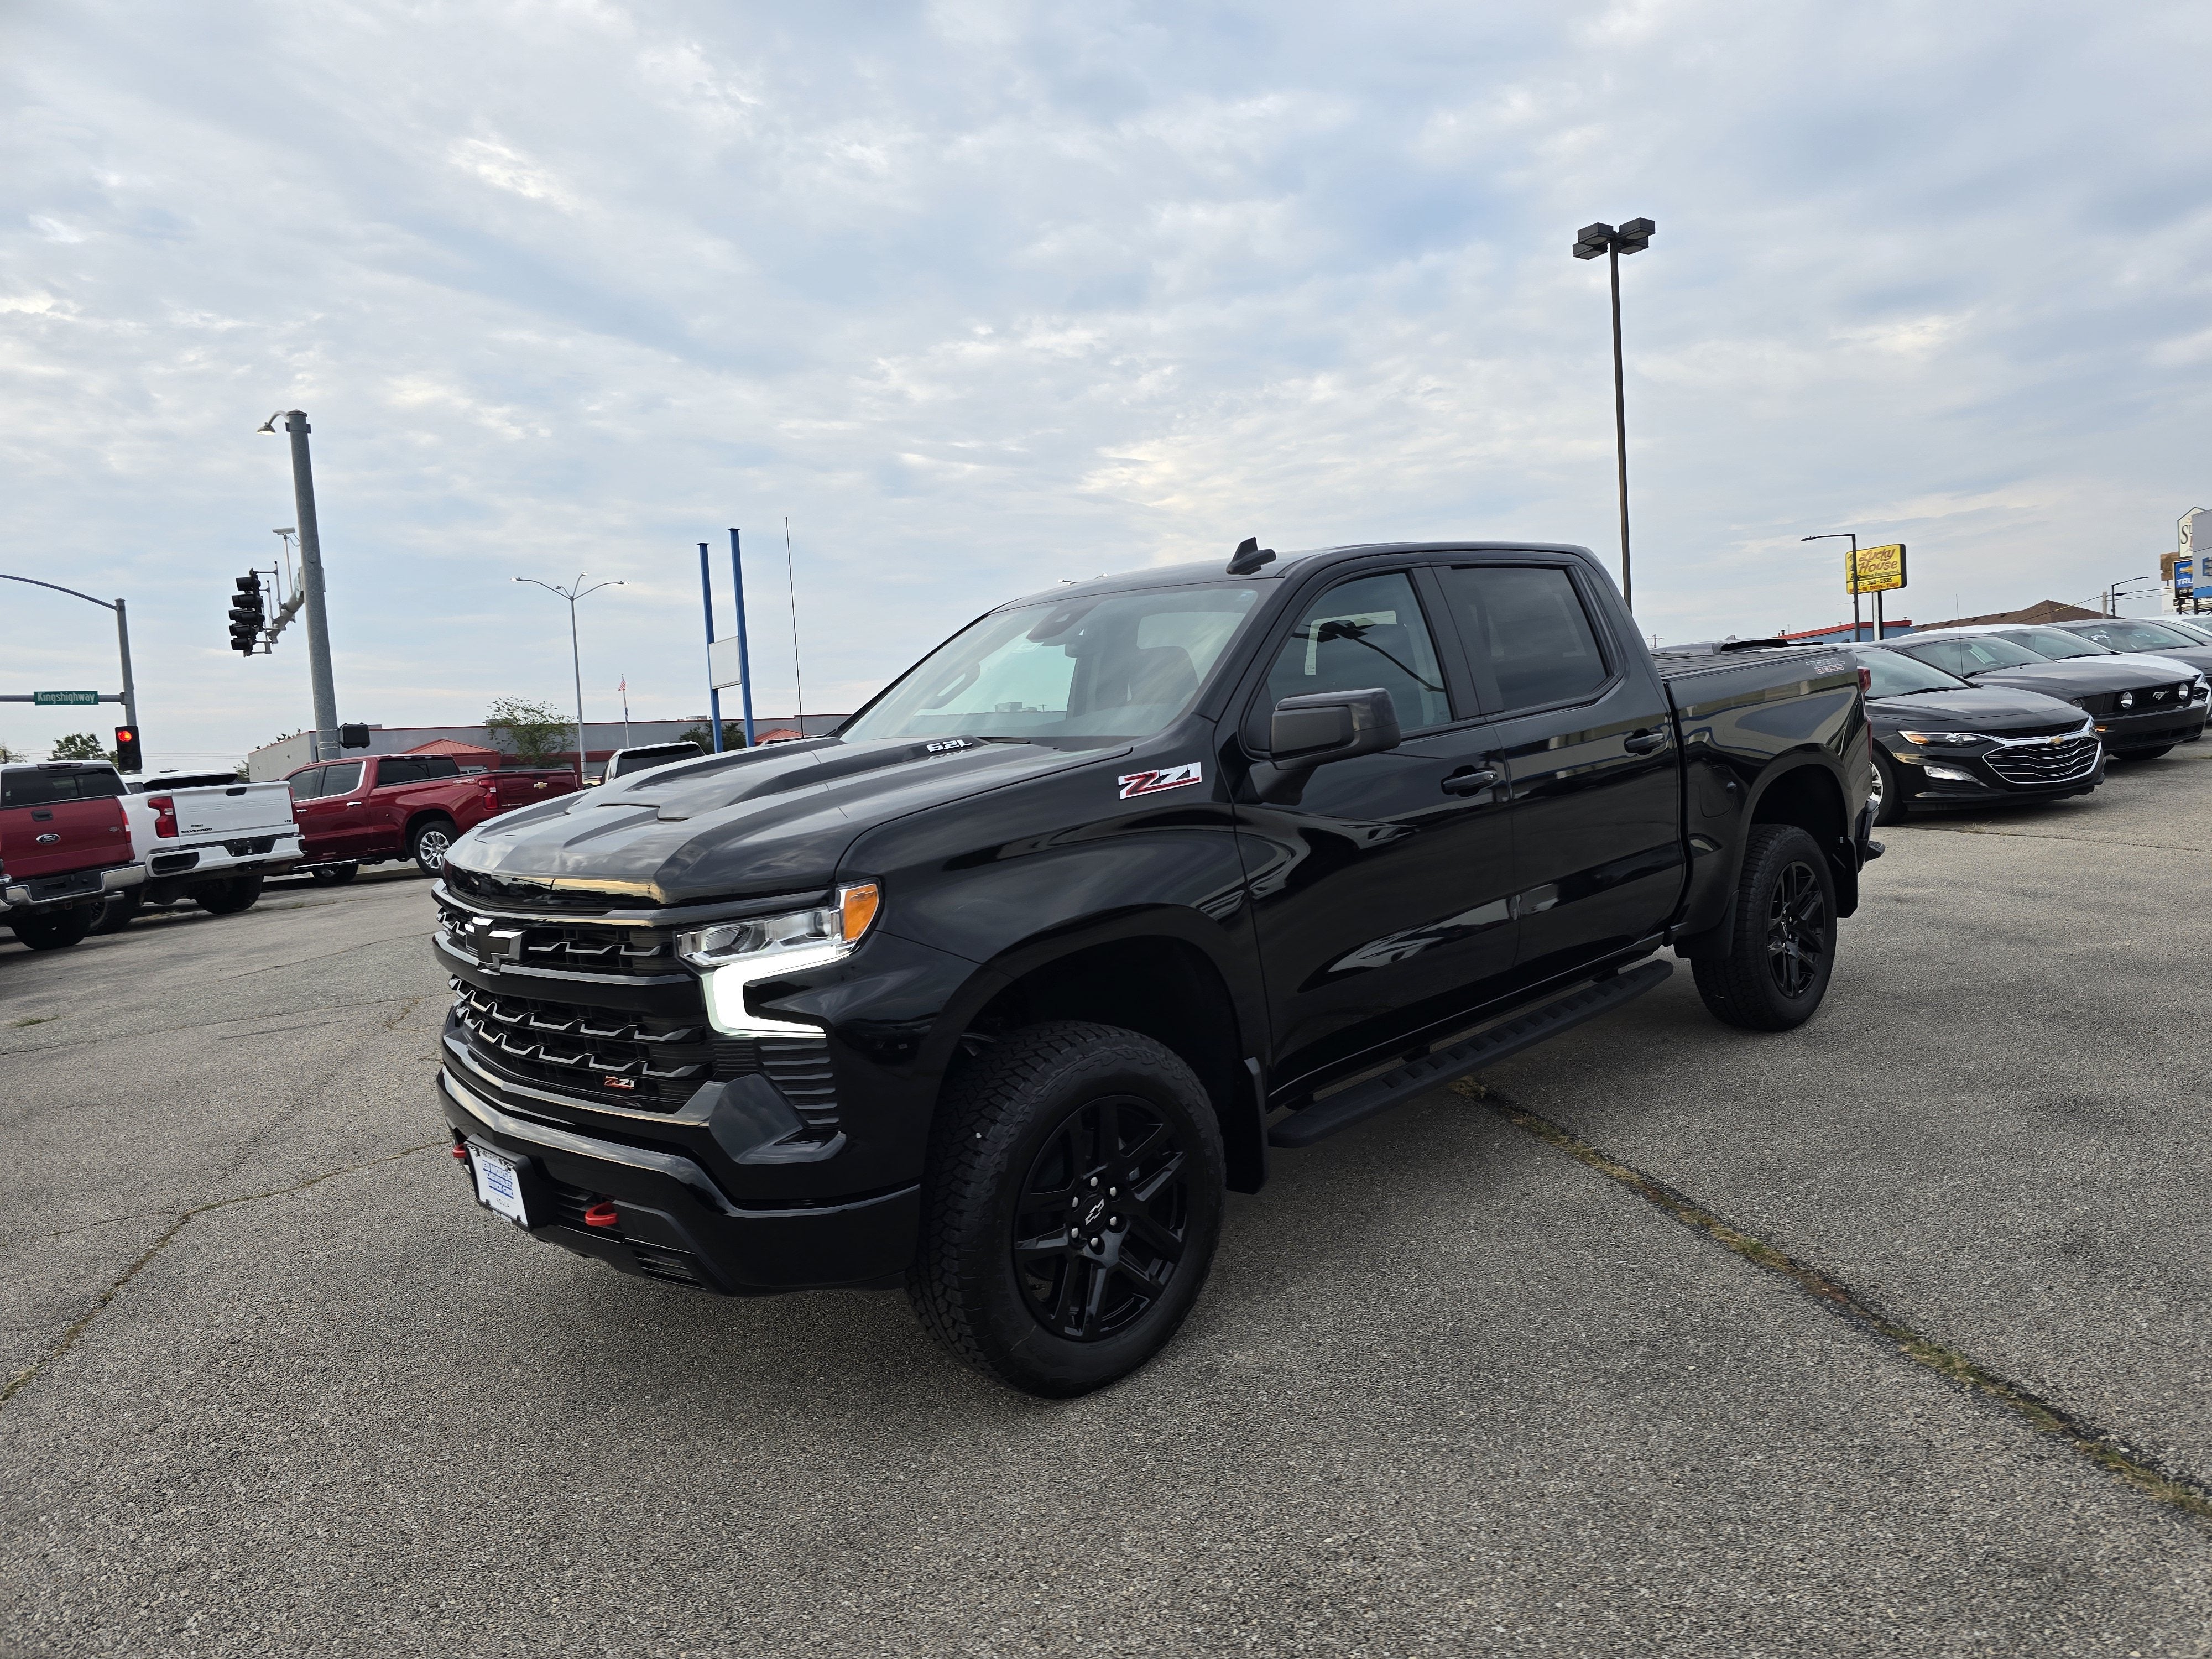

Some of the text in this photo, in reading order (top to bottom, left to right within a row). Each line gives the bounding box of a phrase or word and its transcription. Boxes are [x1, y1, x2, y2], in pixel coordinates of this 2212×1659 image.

[1859, 548, 1896, 562] Lucky
[1858, 560, 1898, 573] House
[1806, 657, 1845, 669] TRAIL
[1814, 664, 1844, 675] BOSS
[37, 692, 95, 705] Kingshighway
[1118, 761, 1202, 800] Z71
[604, 1076, 636, 1089] Z71
